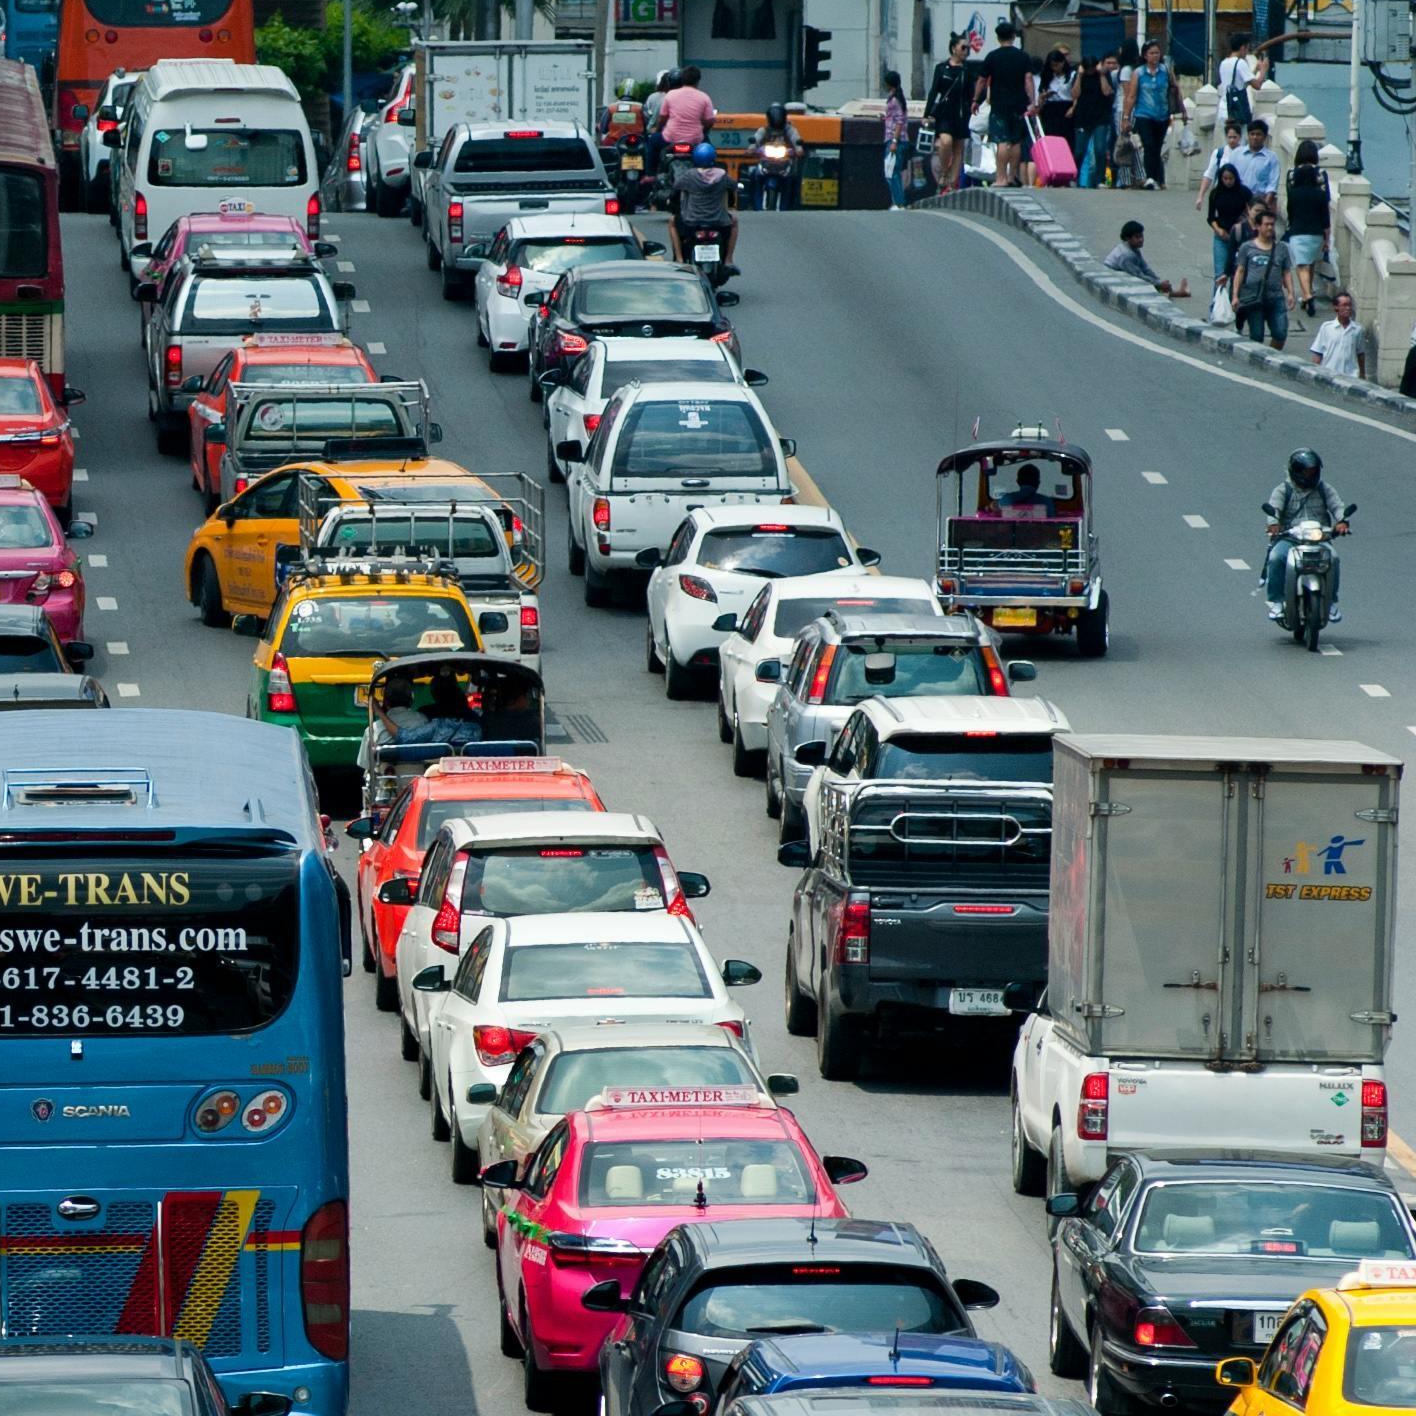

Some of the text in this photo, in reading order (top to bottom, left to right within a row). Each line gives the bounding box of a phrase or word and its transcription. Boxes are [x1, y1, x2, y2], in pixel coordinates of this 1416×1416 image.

[228, 203, 246, 211] TAXI
[426, 633, 456, 645] TAXI
[1265, 883, 1373, 901] TST EXPRESS
[628, 1090, 724, 1104] TAXI-METER
[62, 1105, 131, 1117] SCANIA
